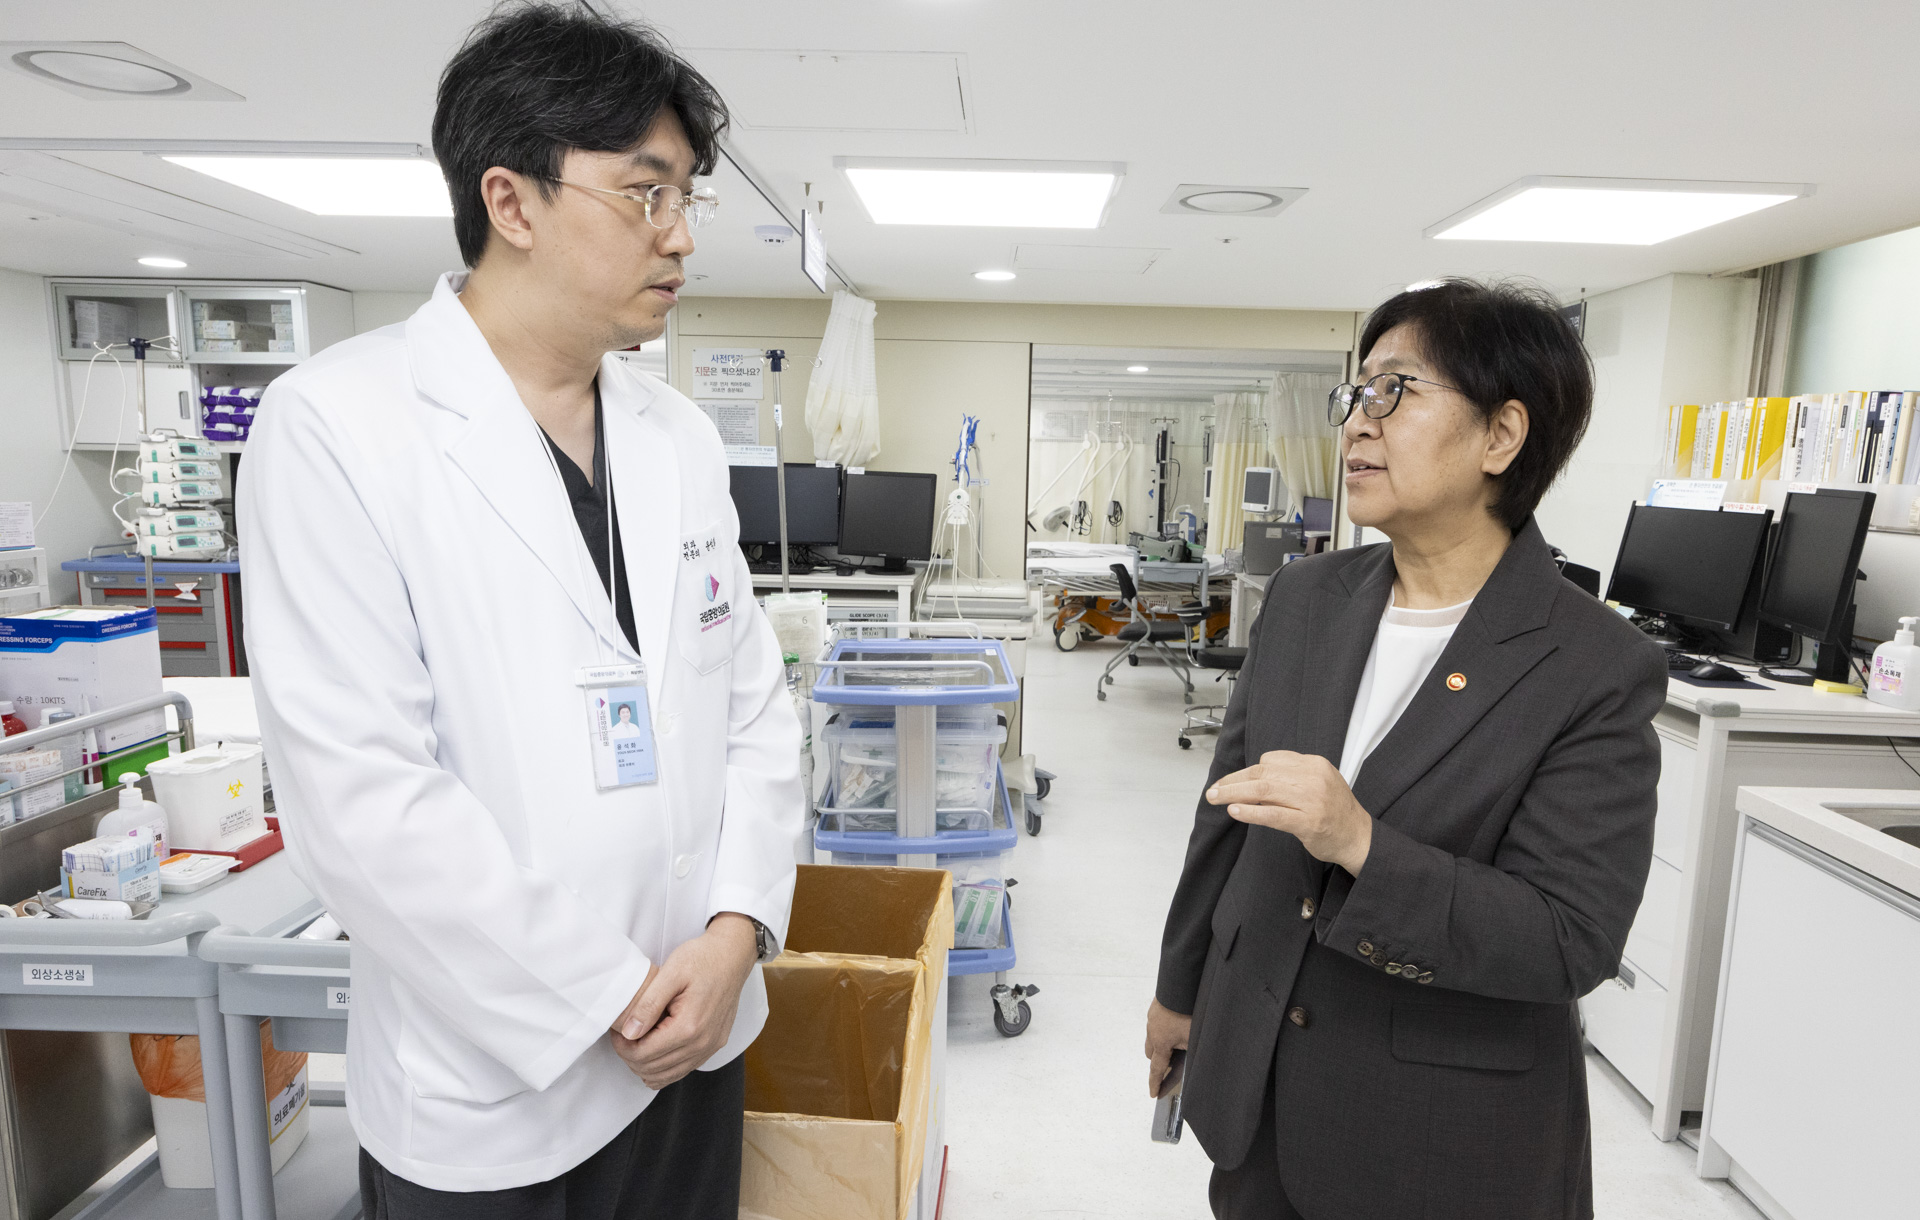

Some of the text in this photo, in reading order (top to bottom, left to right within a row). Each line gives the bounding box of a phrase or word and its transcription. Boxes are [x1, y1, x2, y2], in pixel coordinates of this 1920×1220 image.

[695, 366, 760, 376] 지문은 찍으셨나요?
[802, 616, 808, 624] 6
[102, 625, 122, 634] DRESSING
[121, 622, 138, 630] FORCEPS
[1879, 668, 1902, 678] 손소독제
[16, 696, 32, 704] 수량
[40, 696, 66, 704] 10KITS
[77, 886, 106, 896] CareFix
[32, 968, 85, 981] 외상소생실
[274, 1082, 306, 1126] 의료폐기물
